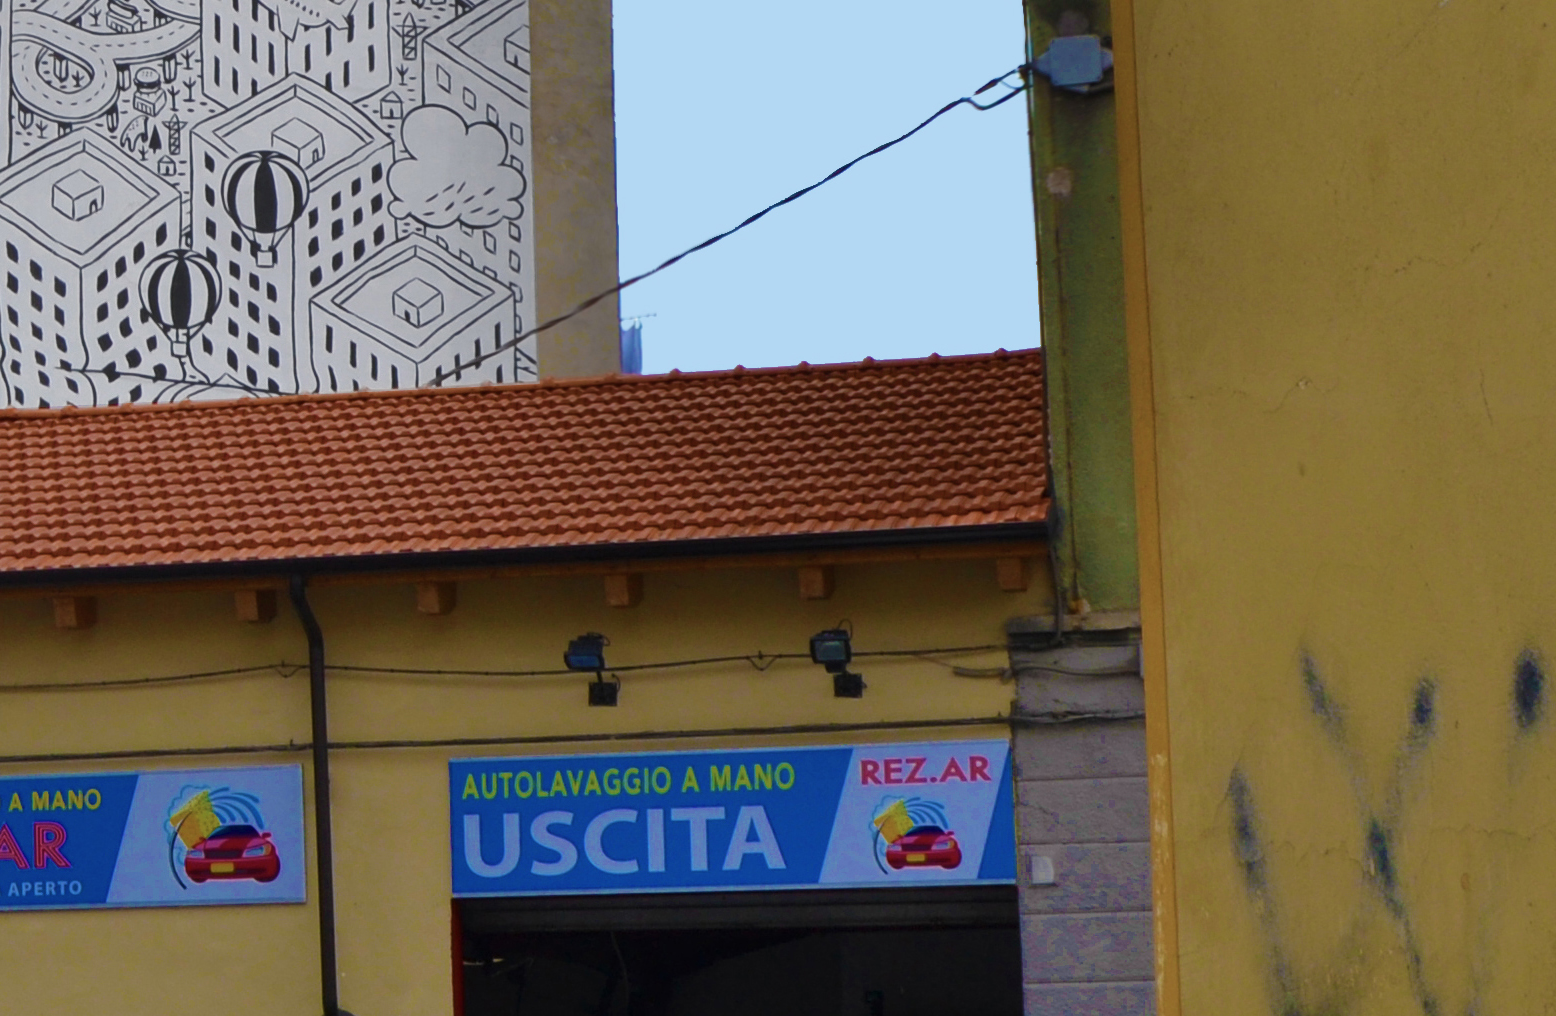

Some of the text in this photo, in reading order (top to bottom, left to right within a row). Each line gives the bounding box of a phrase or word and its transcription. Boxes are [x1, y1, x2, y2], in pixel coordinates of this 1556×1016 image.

[462, 761, 795, 798] AUTOLAVAGGIO A MANO
[859, 755, 991, 785] REZ.AR
[8, 791, 24, 811] A
[31, 788, 102, 811] MANO
[463, 805, 787, 878] USCITA
[9, 879, 83, 897] APERTO
